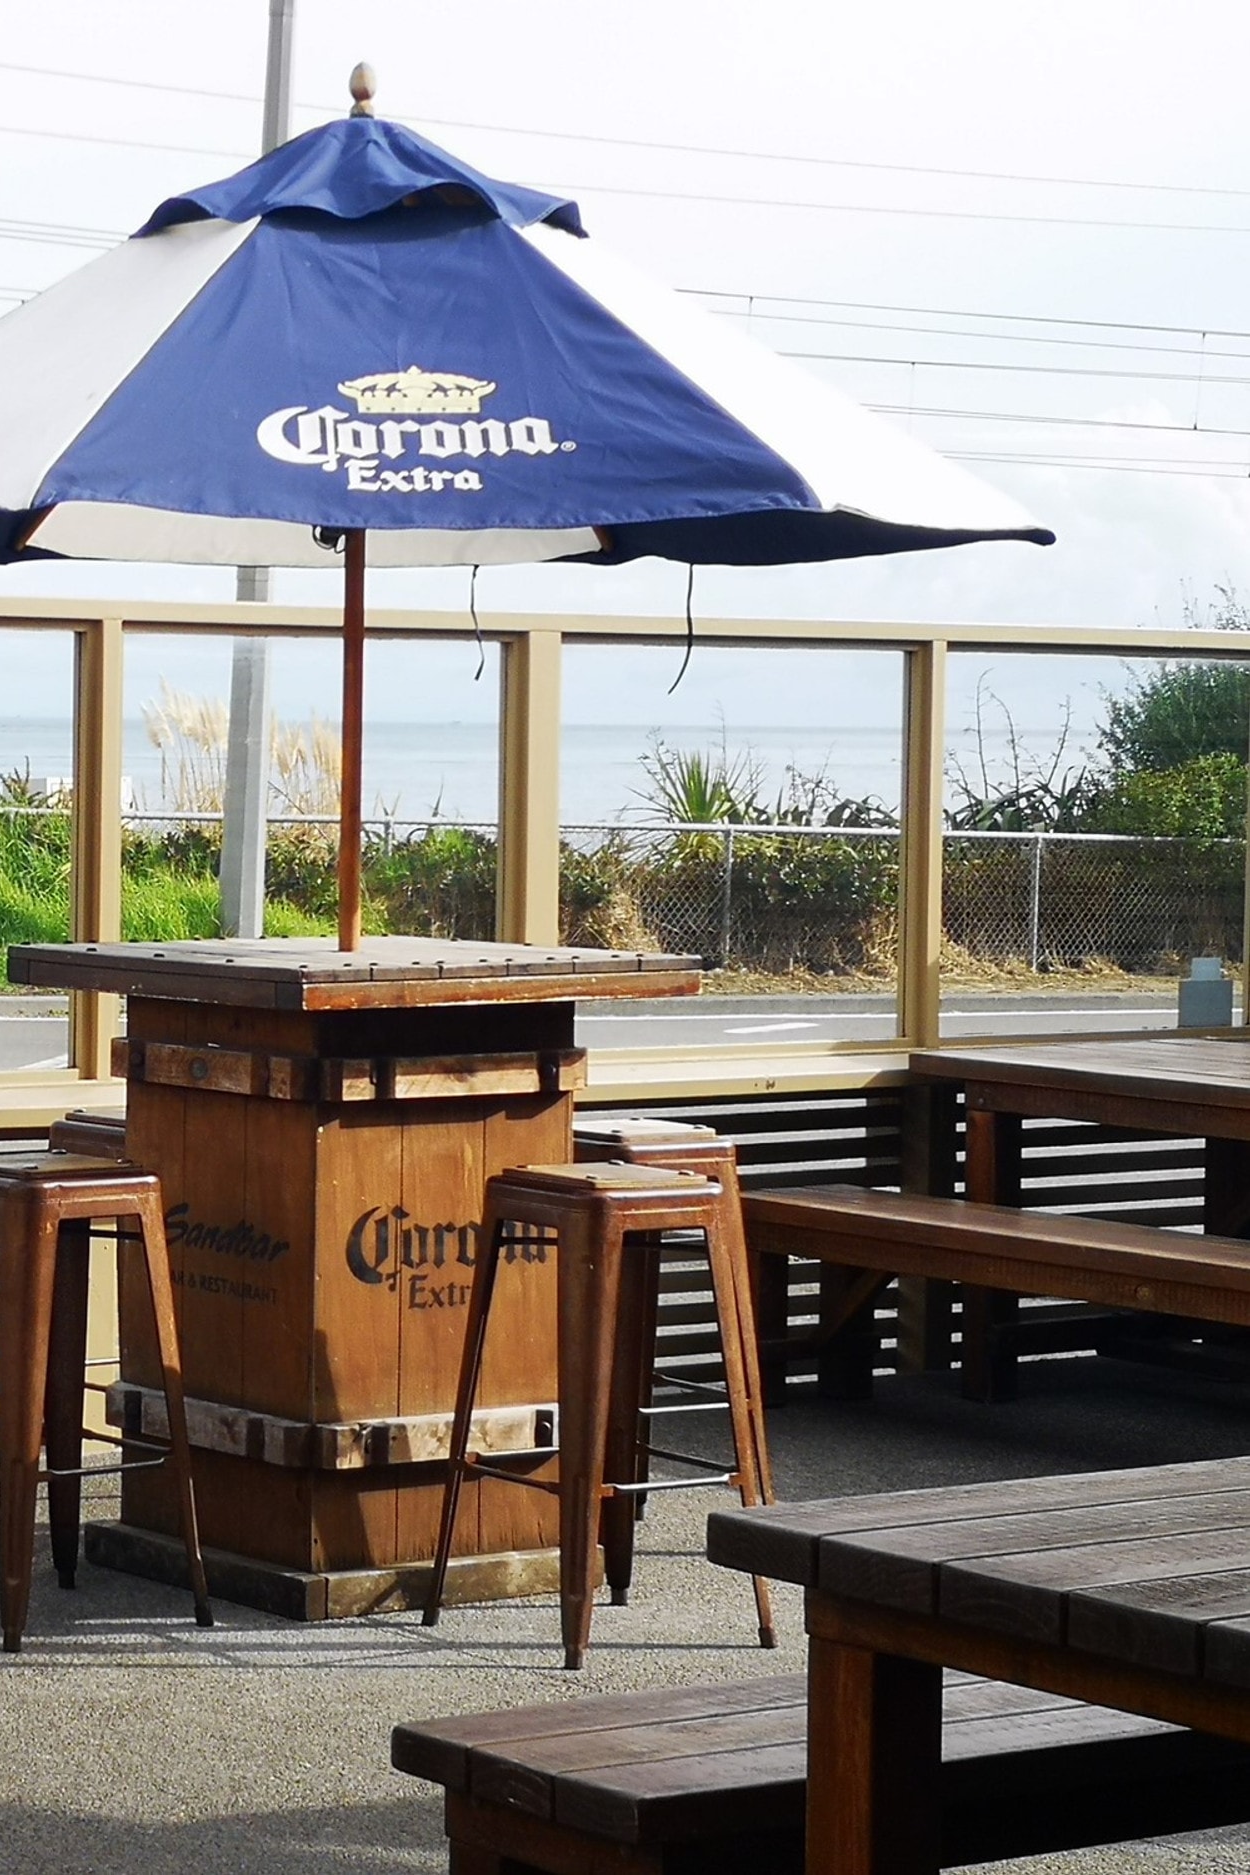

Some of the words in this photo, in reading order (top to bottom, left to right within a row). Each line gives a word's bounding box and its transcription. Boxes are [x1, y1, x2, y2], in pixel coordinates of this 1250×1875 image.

[345, 458, 483, 493] Extra
[165, 1202, 290, 1262] Sandbar
[199, 1273, 278, 1305] RESTAURANT
[408, 1274, 473, 1310] Extr
